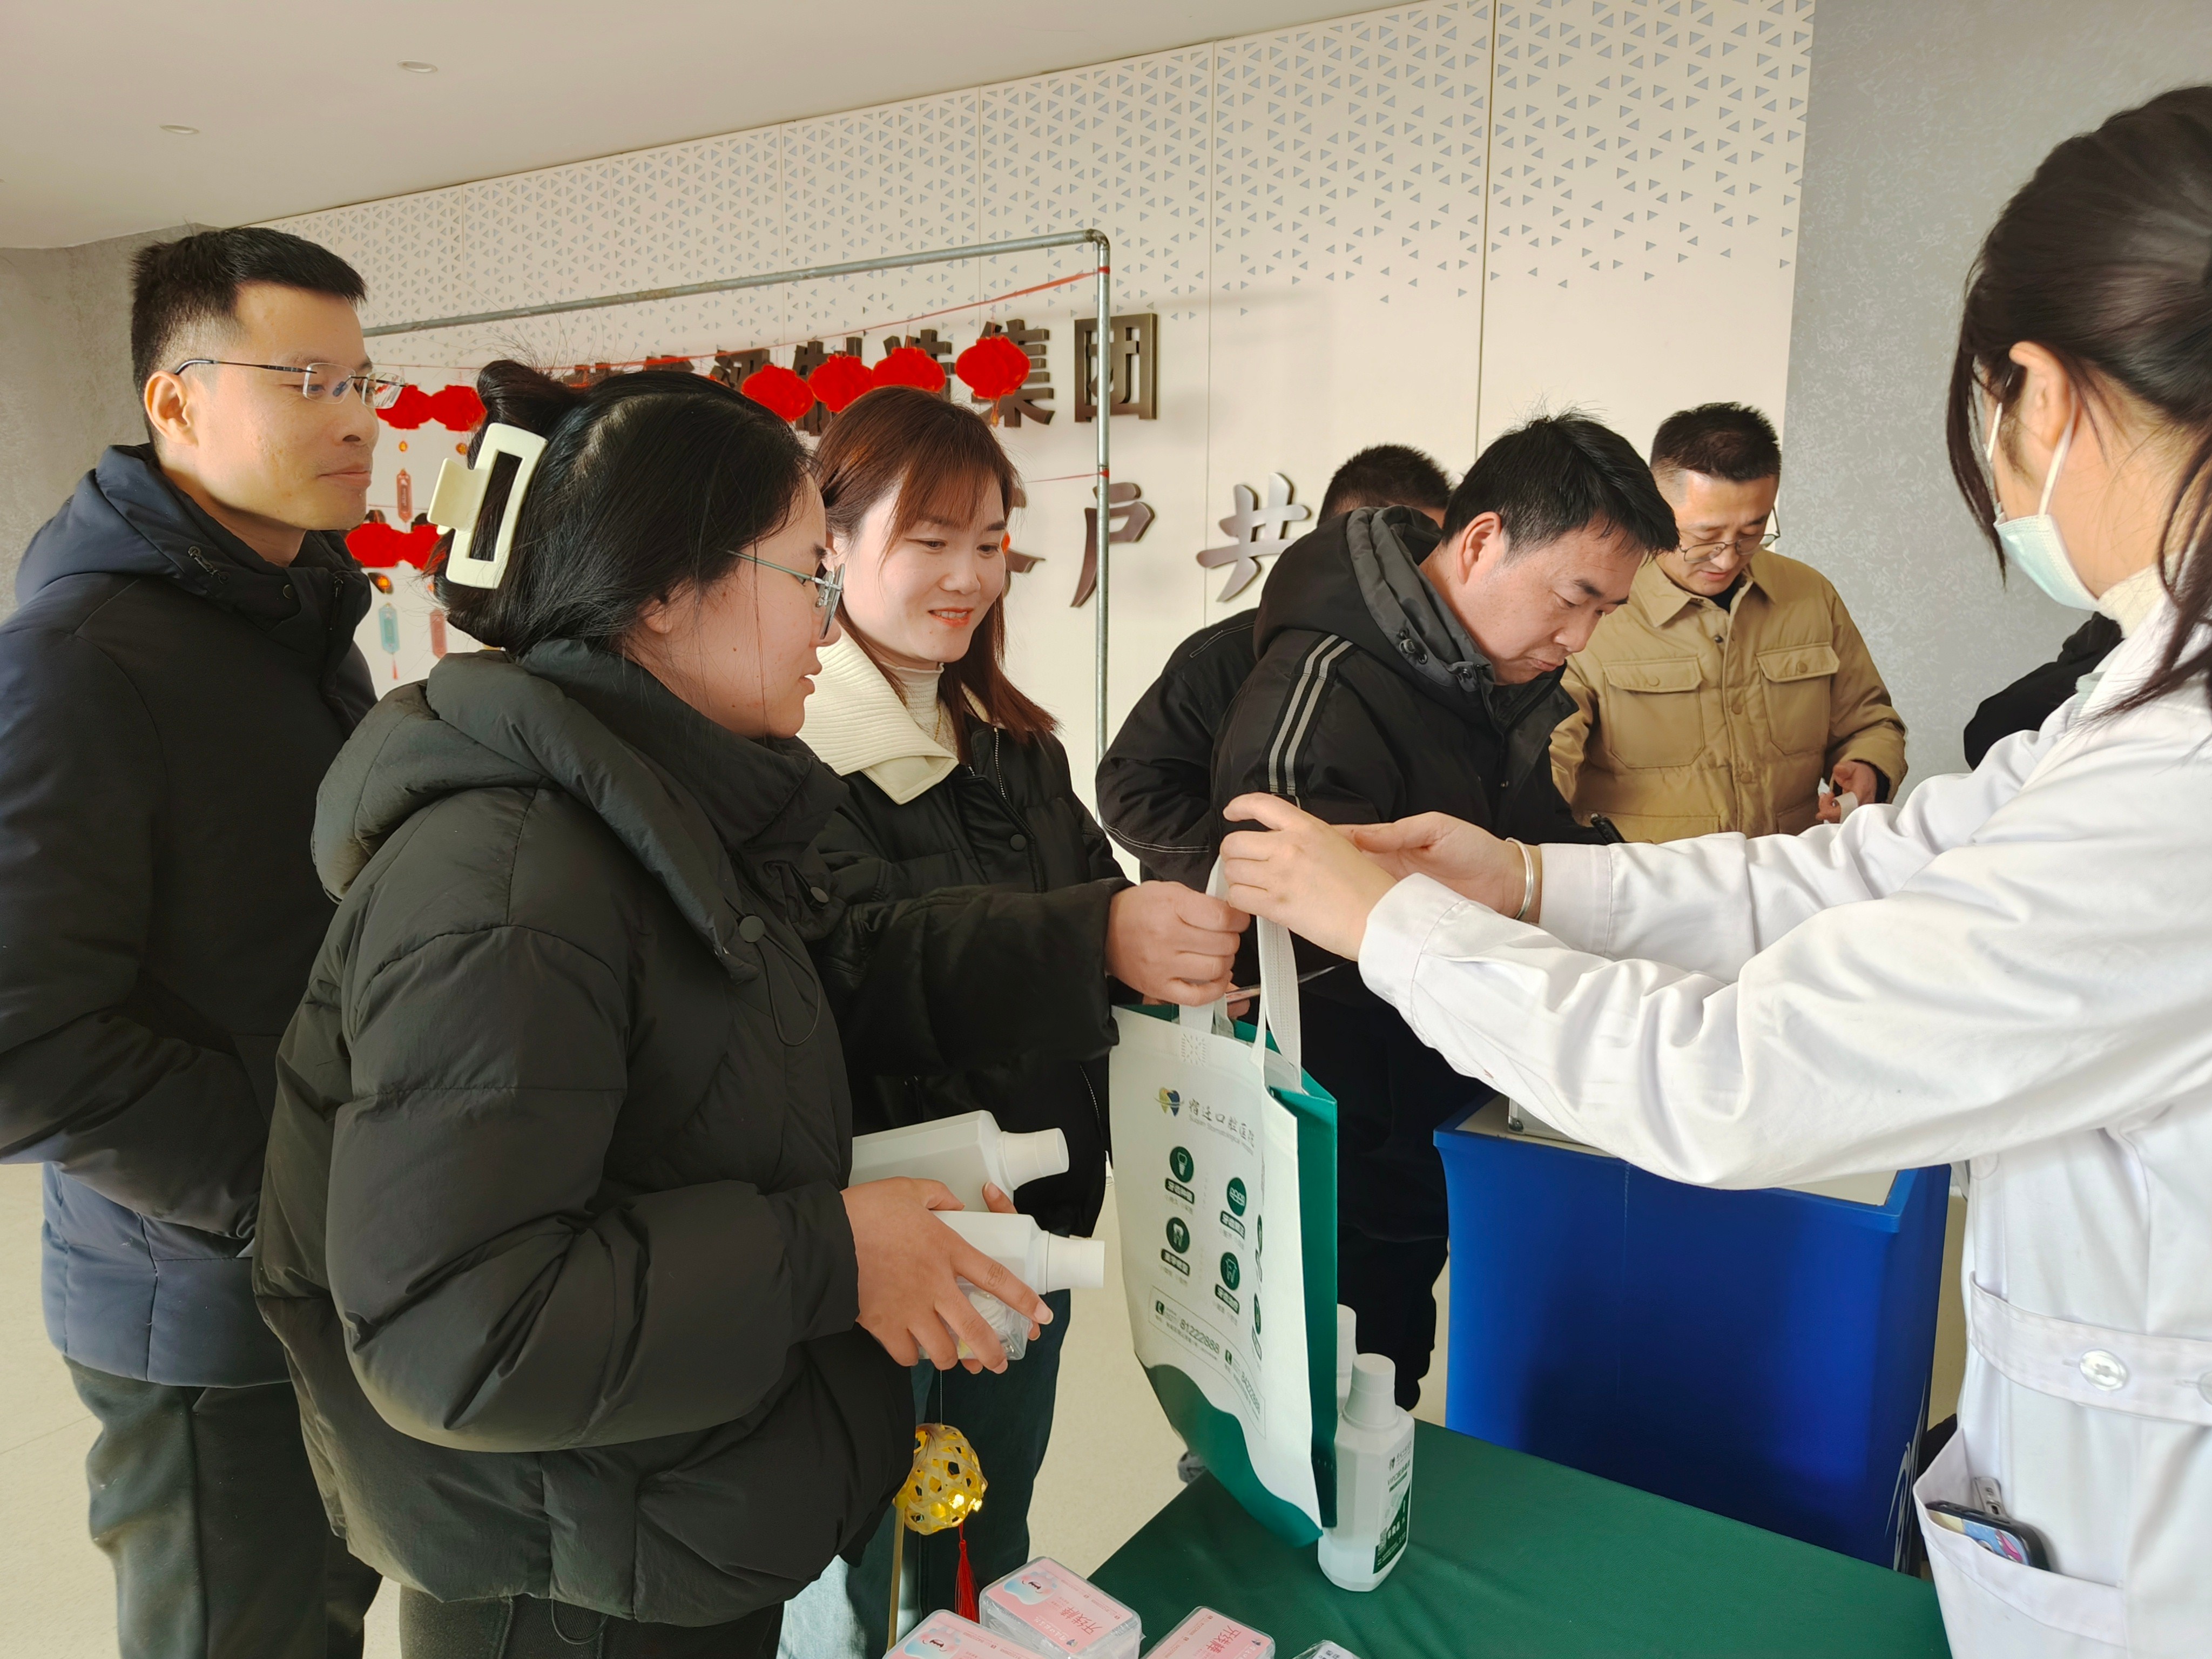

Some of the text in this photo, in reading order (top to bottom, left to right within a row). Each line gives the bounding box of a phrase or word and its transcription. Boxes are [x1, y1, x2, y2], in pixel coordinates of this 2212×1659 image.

[1180, 1319, 1220, 1354] 81222888
[1060, 1607, 1103, 1635] 牙线棒
[1206, 1625, 1242, 1654] 牙线棒
